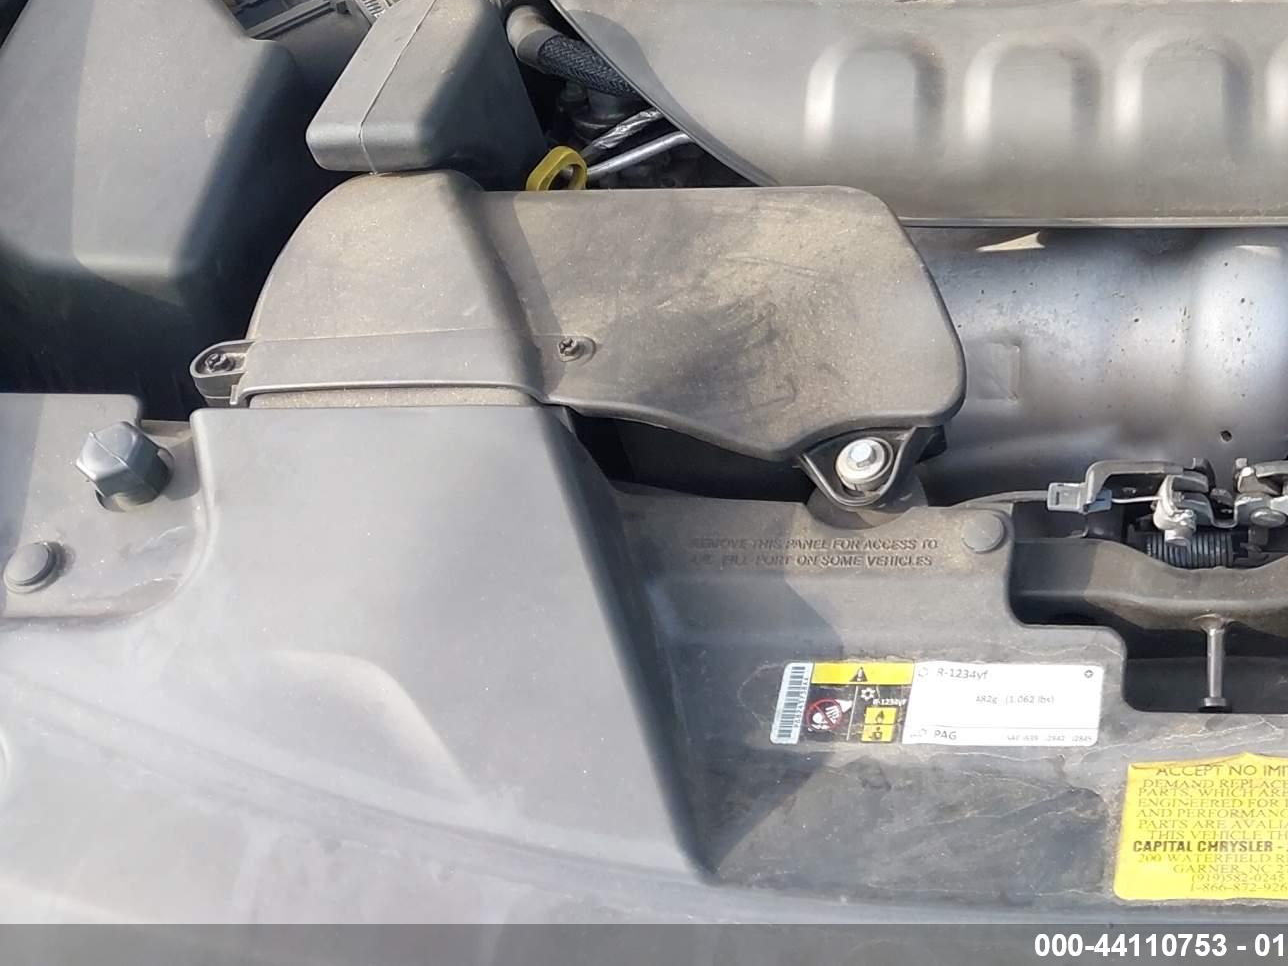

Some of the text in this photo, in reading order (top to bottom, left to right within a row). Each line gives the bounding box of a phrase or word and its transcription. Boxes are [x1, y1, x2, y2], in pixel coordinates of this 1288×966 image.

[753, 538, 784, 550] THIS
[785, 538, 829, 550] PANEL
[832, 538, 860, 550] FOR
[863, 538, 918, 550] ACCESS
[921, 538, 939, 549] TO
[755, 554, 793, 567] PORT
[796, 555, 818, 567] ON
[819, 555, 864, 567] SOME
[866, 555, 934, 567] VEHICLES
[936, 667, 989, 681] R-1234yf
[933, 729, 958, 741] PAG
[1156, 764, 1223, 777] ACCEPT
[1229, 764, 1258, 776] NO
[1143, 778, 1215, 789] DEMAND
[1198, 787, 1255, 797] WHICH
[1138, 797, 1244, 808] ENGINEERED
[1247, 797, 1280, 808] FOR
[1136, 808, 1173, 818] AND
[1137, 819, 1188, 830] PARTS
[1193, 819, 1225, 829] ARE
[1150, 830, 1186, 840] THIS
[1189, 830, 1262, 840] VEHICLE
[1132, 840, 1193, 853] CAPITAL
[1196, 840, 1274, 852] CHRYSLER
[1137, 853, 1163, 863] 200
[1167, 853, 1272, 864] WATERFIELD
[1248, 863, 1273, 874] NC
